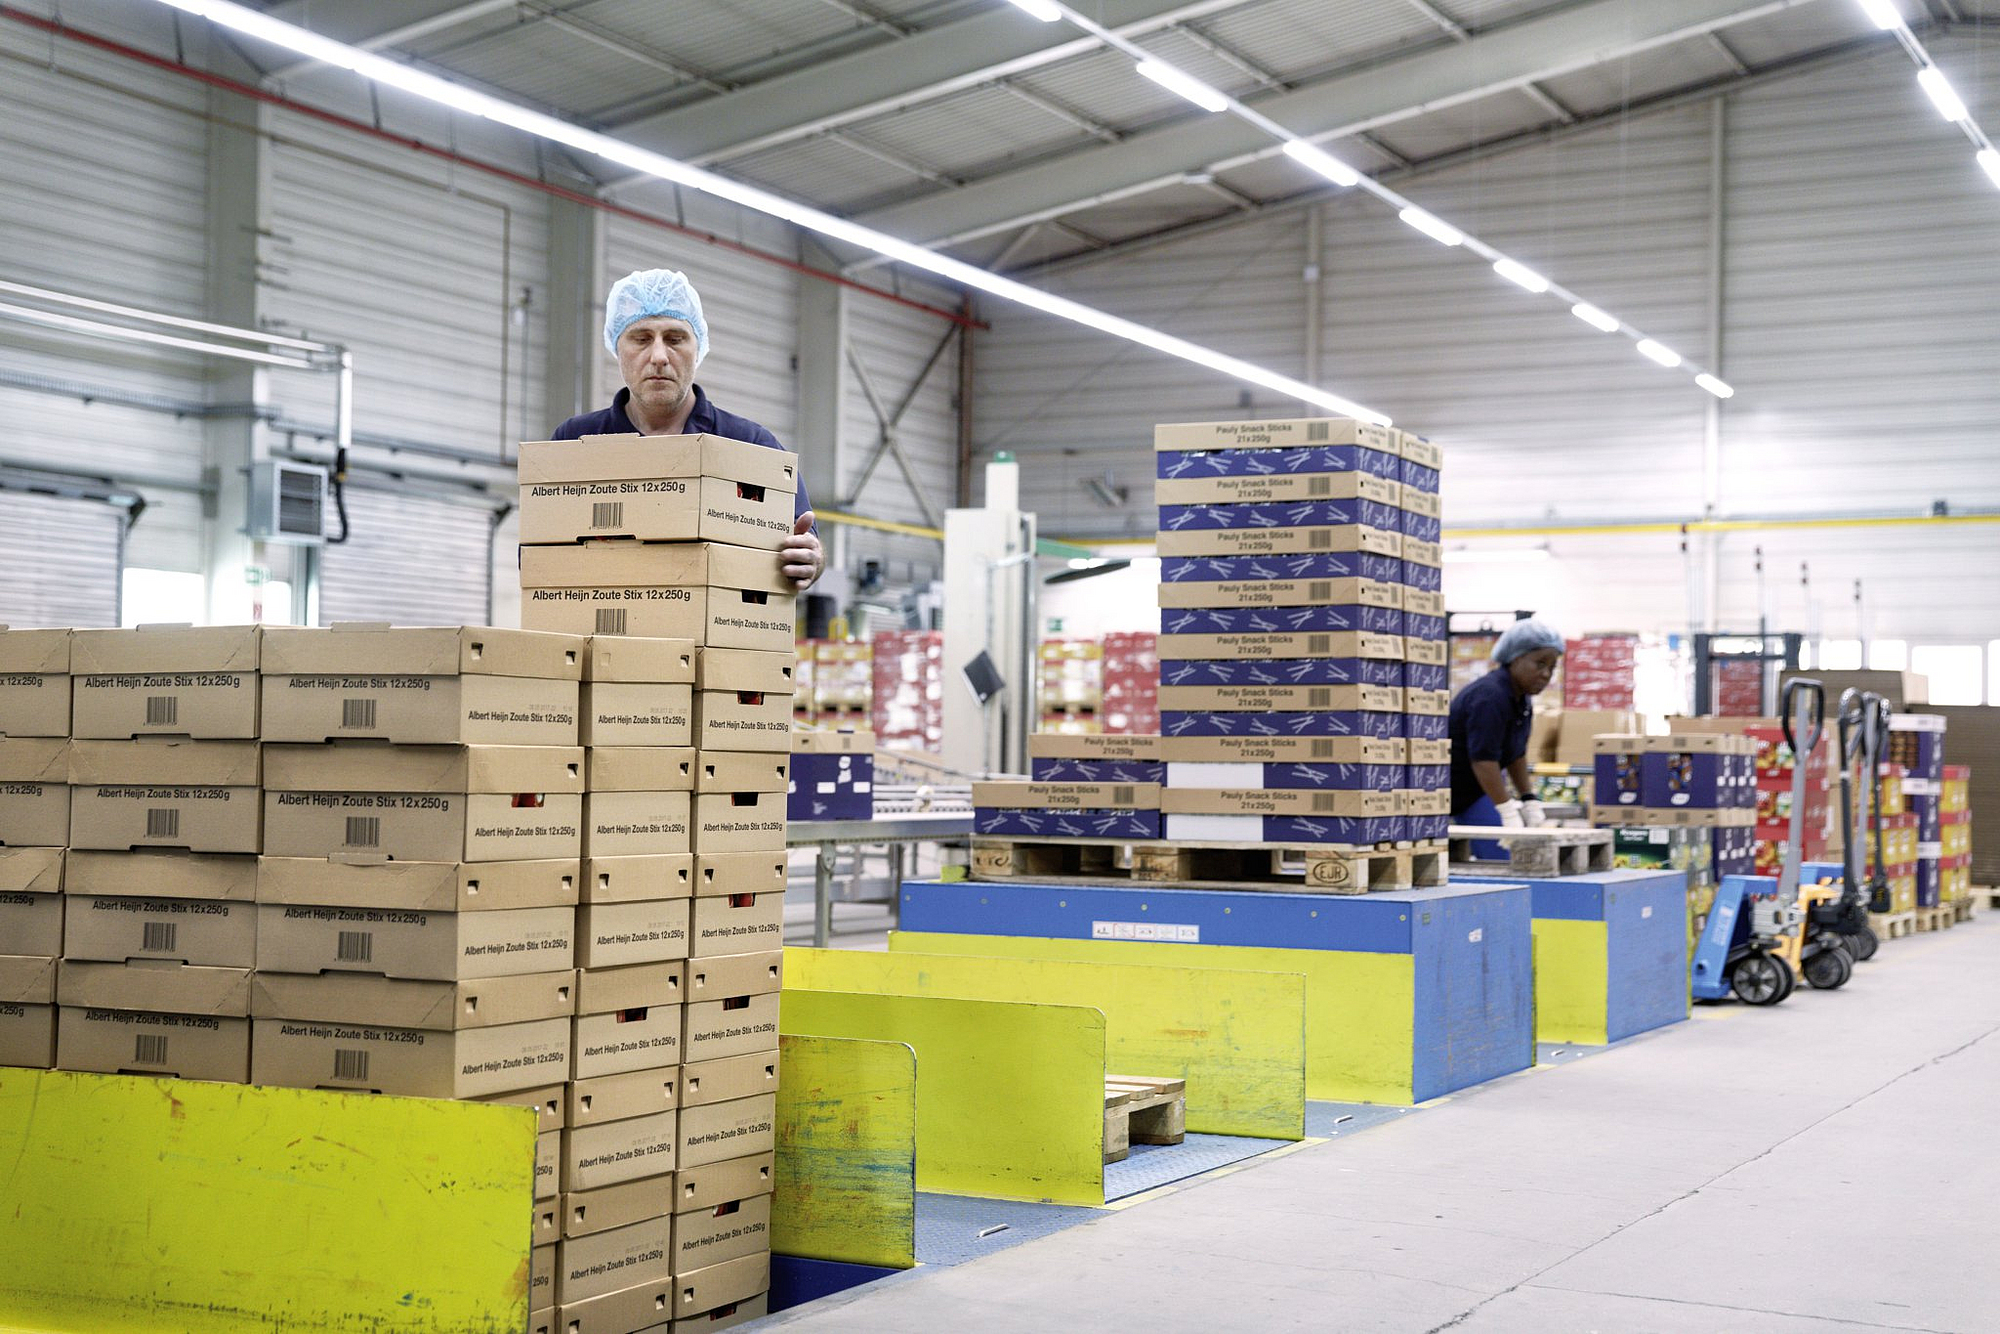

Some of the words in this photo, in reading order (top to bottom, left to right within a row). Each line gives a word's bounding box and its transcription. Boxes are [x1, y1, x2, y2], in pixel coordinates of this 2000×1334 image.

[531, 486, 560, 496] Albert
[562, 484, 587, 497] Heijn
[589, 484, 618, 494] Zoute
[620, 482, 639, 493] Stix
[641, 481, 685, 494] 12x250g
[707, 508, 724, 519] Albert
[725, 512, 739, 523] Heijn
[740, 514, 755, 526] Zoute
[756, 518, 767, 527] Stix
[767, 521, 790, 534] 12x250g
[532, 590, 562, 600] Albert
[564, 590, 590, 602] Heijn
[592, 590, 621, 600] Zoute
[624, 589, 643, 600] Stix
[646, 589, 691, 602] 12x250g
[714, 616, 730, 626] Albert
[731, 618, 744, 629] Heijn
[744, 619, 759, 629] Zoute
[760, 620, 769, 629] Stix
[770, 622, 791, 633] 12x250g
[7, 677, 43, 687] 12x250g
[85, 678, 114, 688] Albert
[115, 674, 141, 690] Heijn
[143, 676, 172, 687] Zoute
[174, 676, 193, 687] Stix
[196, 675, 240, 688] 12x250g
[289, 678, 316, 688] Albert
[317, 678, 340, 690] Heijn
[342, 679, 368, 688] Zoute
[370, 678, 387, 689] Stix
[390, 678, 430, 691] 12x250g
[1242, 688, 1266, 696] Snack
[468, 710, 490, 720] Albert
[491, 711, 509, 723] Heijn
[509, 712, 529, 722] Zoute
[530, 712, 543, 722] Stix
[545, 713, 572, 725] 12x250g
[598, 715, 616, 724] Albert
[617, 715, 632, 725] Heijn
[633, 715, 649, 724] Zoute
[650, 715, 661, 724] Stix
[662, 716, 686, 727] 12x250g
[709, 719, 726, 728] Albert
[726, 720, 740, 731] Heijn
[740, 721, 756, 730] Zoute
[756, 721, 766, 730] Stix
[767, 722, 789, 733] 12x250g
[6, 786, 43, 796] 12x250g
[96, 788, 122, 798] Albert
[123, 789, 145, 800] Heijn
[147, 789, 172, 799] Zoute
[173, 789, 190, 799] Stix
[192, 789, 230, 802] 12x250g
[277, 791, 310, 805] Albert
[312, 794, 339, 808] Heijn
[342, 795, 373, 807] Zoute
[376, 796, 397, 808] Stix
[400, 797, 449, 812] 12x250g
[475, 828, 496, 837] Albert
[497, 827, 514, 838] Heijn
[515, 827, 534, 836] Zoute
[535, 826, 547, 836] Stix
[549, 826, 576, 837] 12x250g
[703, 823, 720, 832] Albert
[720, 823, 734, 833] Heijn
[734, 822, 750, 831] Zoute
[750, 822, 760, 831] Stix
[761, 822, 783, 832] 12x250g
[92, 900, 118, 910] Albert
[120, 901, 142, 914] Heijn
[143, 902, 169, 913] Zoute
[170, 903, 187, 913] Stix
[190, 904, 229, 917] 12x250g
[283, 906, 312, 919] Albert
[313, 909, 336, 922] Heijn
[338, 910, 364, 921] Zoute
[366, 911, 384, 922] Stix
[386, 913, 426, 927] 12x250g
[597, 936, 615, 945] Albert
[616, 934, 631, 945] Heijn
[631, 933, 648, 942] Zoute
[649, 931, 660, 941] Stix
[661, 929, 684, 940] 12x250g
[701, 929, 718, 938] Albert
[718, 927, 732, 937] Heijn
[732, 926, 747, 935] Zoute
[747, 925, 757, 934] Stix
[758, 923, 779, 933] 12x250g
[84, 1009, 111, 1022] Albert
[112, 1012, 134, 1025] Heijn
[135, 1014, 160, 1025] Zoute
[162, 1016, 179, 1026] Stix
[182, 1017, 219, 1031] 12x250g
[280, 1025, 308, 1036] Albert
[309, 1027, 332, 1040] Heijn
[334, 1028, 361, 1040] Zoute
[363, 1030, 381, 1040] Stix
[383, 1031, 424, 1046] 12x250g
[694, 1032, 711, 1042] Albert
[711, 1030, 725, 1040] Heijn
[726, 1028, 741, 1037] Zoute
[742, 1026, 752, 1035] Stix
[753, 1023, 775, 1033] 12x250g
[584, 1046, 603, 1057] Albert
[604, 1044, 620, 1054] Heijn
[620, 1042, 638, 1052] Zoute
[638, 1040, 650, 1049] Stix
[651, 1036, 676, 1047] 12x250g
[462, 1064, 483, 1075] Albert
[484, 1061, 501, 1072] Heijn
[502, 1058, 522, 1069] Zoute
[523, 1056, 535, 1066] Stix
[537, 1052, 564, 1064] 12x250g
[578, 1157, 598, 1169] Albert
[599, 1154, 614, 1165] Heijn
[615, 1151, 633, 1161] Zoute
[634, 1148, 645, 1158] Stix
[646, 1142, 671, 1154] 12x250g
[536, 1166, 553, 1176] 250g
[682, 1239, 700, 1251] Albert
[700, 1236, 715, 1246] Heijn
[715, 1232, 731, 1243] Zoute
[732, 1229, 742, 1238] Stix
[743, 1222, 765, 1234] 12x250g
[570, 1268, 589, 1280] Albert
[590, 1264, 606, 1275] Heijn
[607, 1260, 625, 1271] Zoute
[625, 1256, 637, 1266] Stix
[638, 1250, 663, 1263] 12x250g
